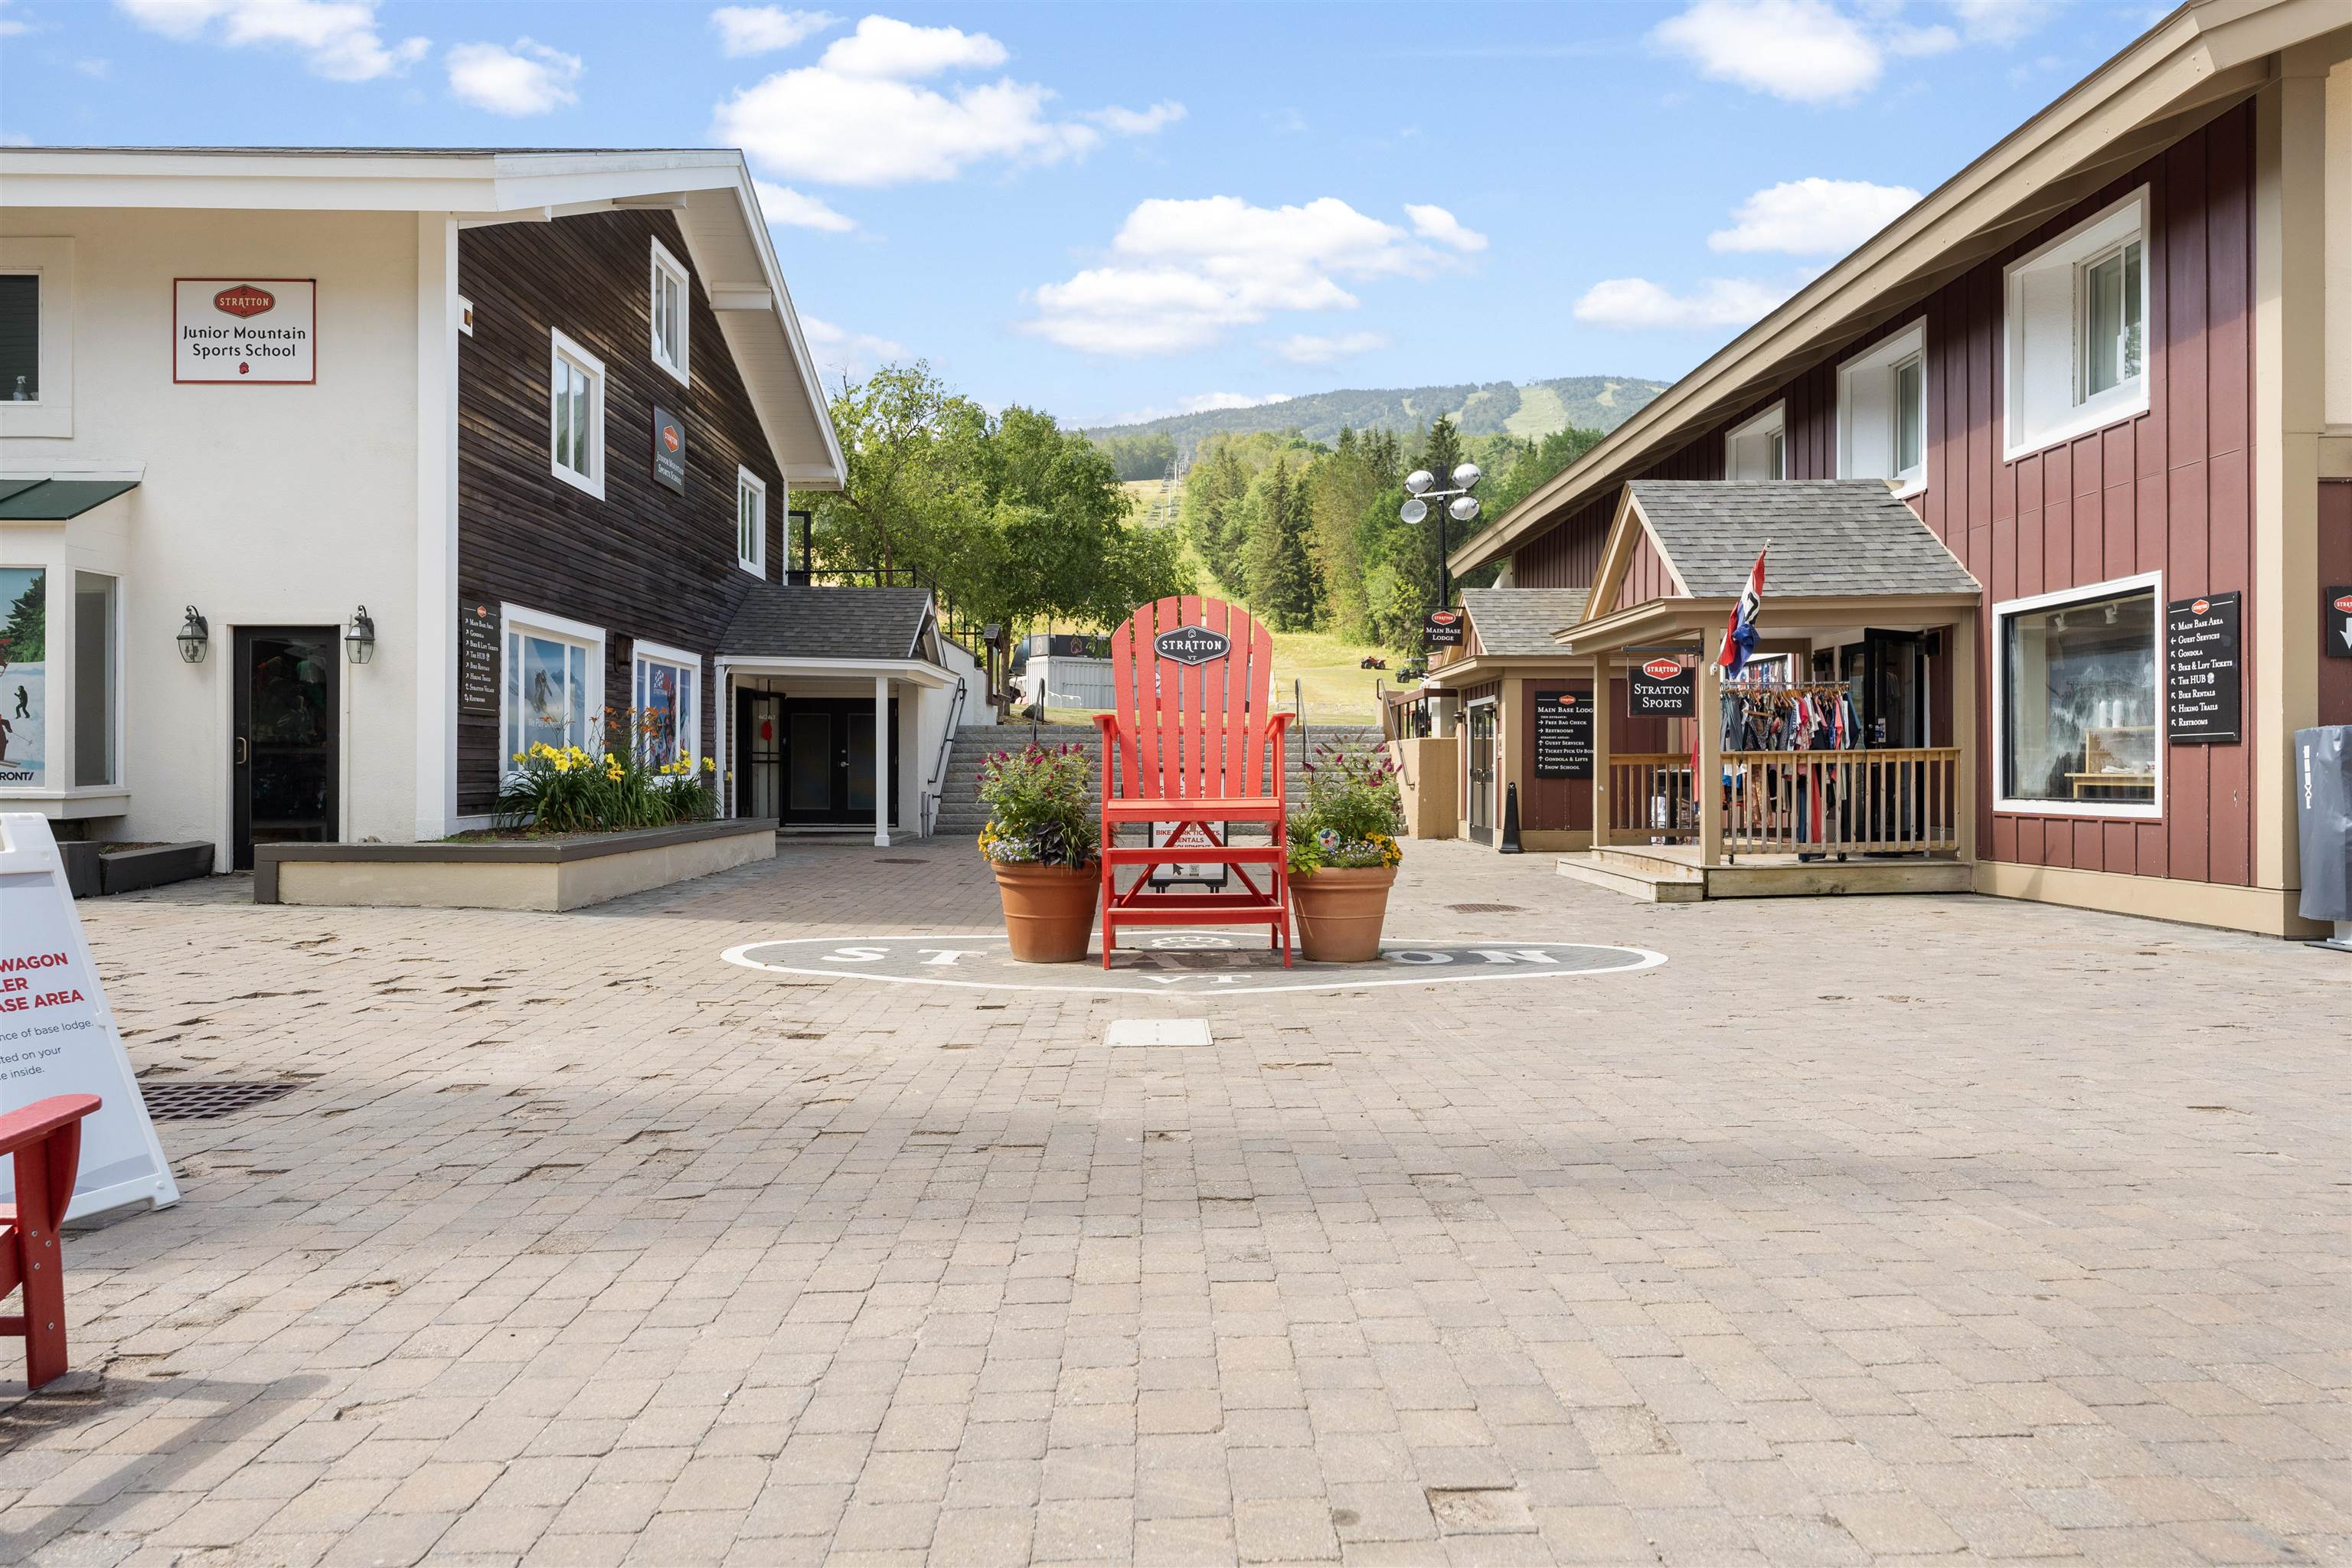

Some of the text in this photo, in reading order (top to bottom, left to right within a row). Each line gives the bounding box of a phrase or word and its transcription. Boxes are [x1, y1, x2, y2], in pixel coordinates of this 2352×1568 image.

[220, 298, 269, 309] STRATTON
[184, 326, 305, 339] Junior Mountain
[193, 344, 295, 359] Sports School
[658, 464, 670, 478] SPORTS
[2178, 617, 2223, 630] MAIN BASE AREA
[1162, 640, 1221, 652] STRATTON
[2178, 649, 2203, 658] GONDOLA
[2178, 659, 2233, 671] BIKE & LIFT TICKETS
[2190, 675, 2206, 684] HUB
[1635, 684, 1689, 694] STRATTON
[2178, 689, 2216, 699] BIKE RENTALS
[1642, 697, 1682, 707] SPORTS
[2199, 703, 2218, 711] TRAILS
[2178, 718, 2208, 727] RESTROOMS
[0, 952, 68, 972] WAGON
[821, 947, 1560, 970] STATON
[1136, 975, 1252, 984] VT
[35, 989, 85, 1008] AREA
[21, 1028, 31, 1037] of
[34, 1026, 60, 1036] base
[61, 1021, 93, 1031] lodge.
[0, 1054, 19, 1063] ted
[38, 1047, 61, 1059] your
[11, 1066, 44, 1078] inside.
